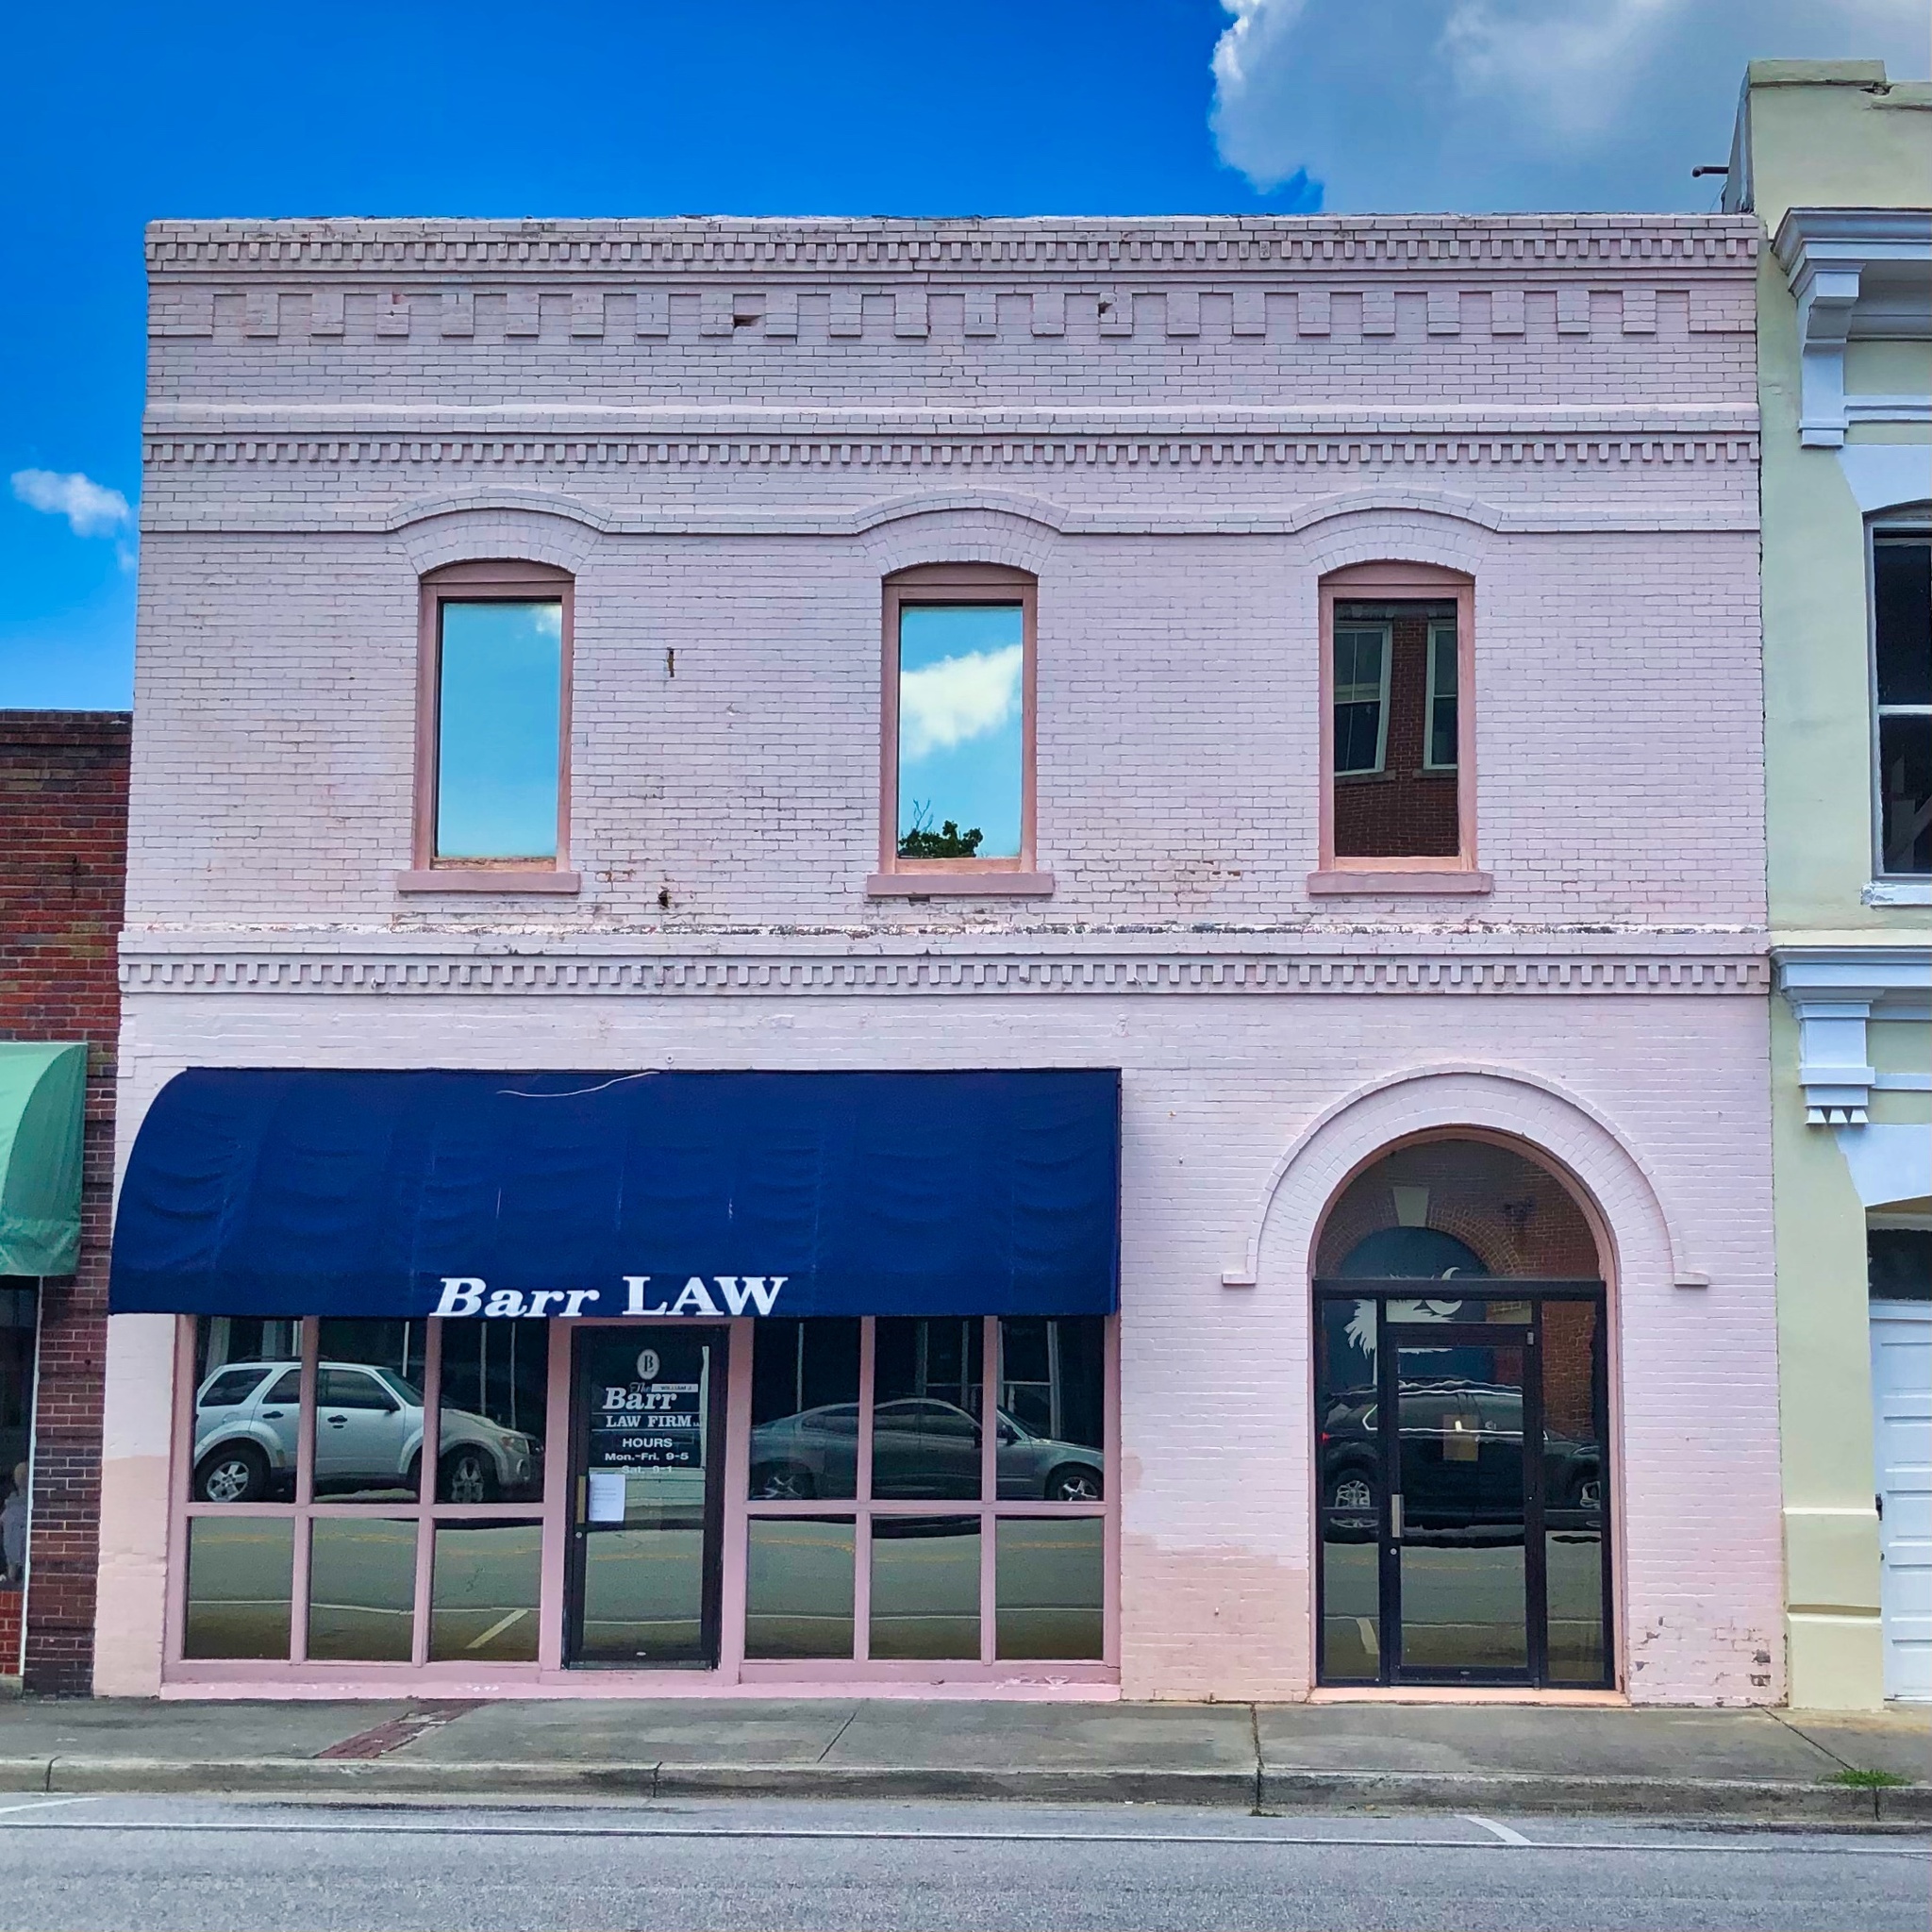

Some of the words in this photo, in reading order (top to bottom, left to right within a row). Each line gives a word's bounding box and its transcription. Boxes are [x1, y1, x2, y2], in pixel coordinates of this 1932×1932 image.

[428, 1276, 600, 1318] Barr
[622, 1275, 789, 1316] LAW
[629, 1382, 652, 1393] The
[602, 1387, 677, 1409] Barr
[606, 1415, 641, 1427] LAW
[647, 1415, 691, 1427] FIRM
[623, 1438, 673, 1448] HOURS
[605, 1453, 659, 1461] Mon.-Fri.
[665, 1452, 690, 1460] 9-5
